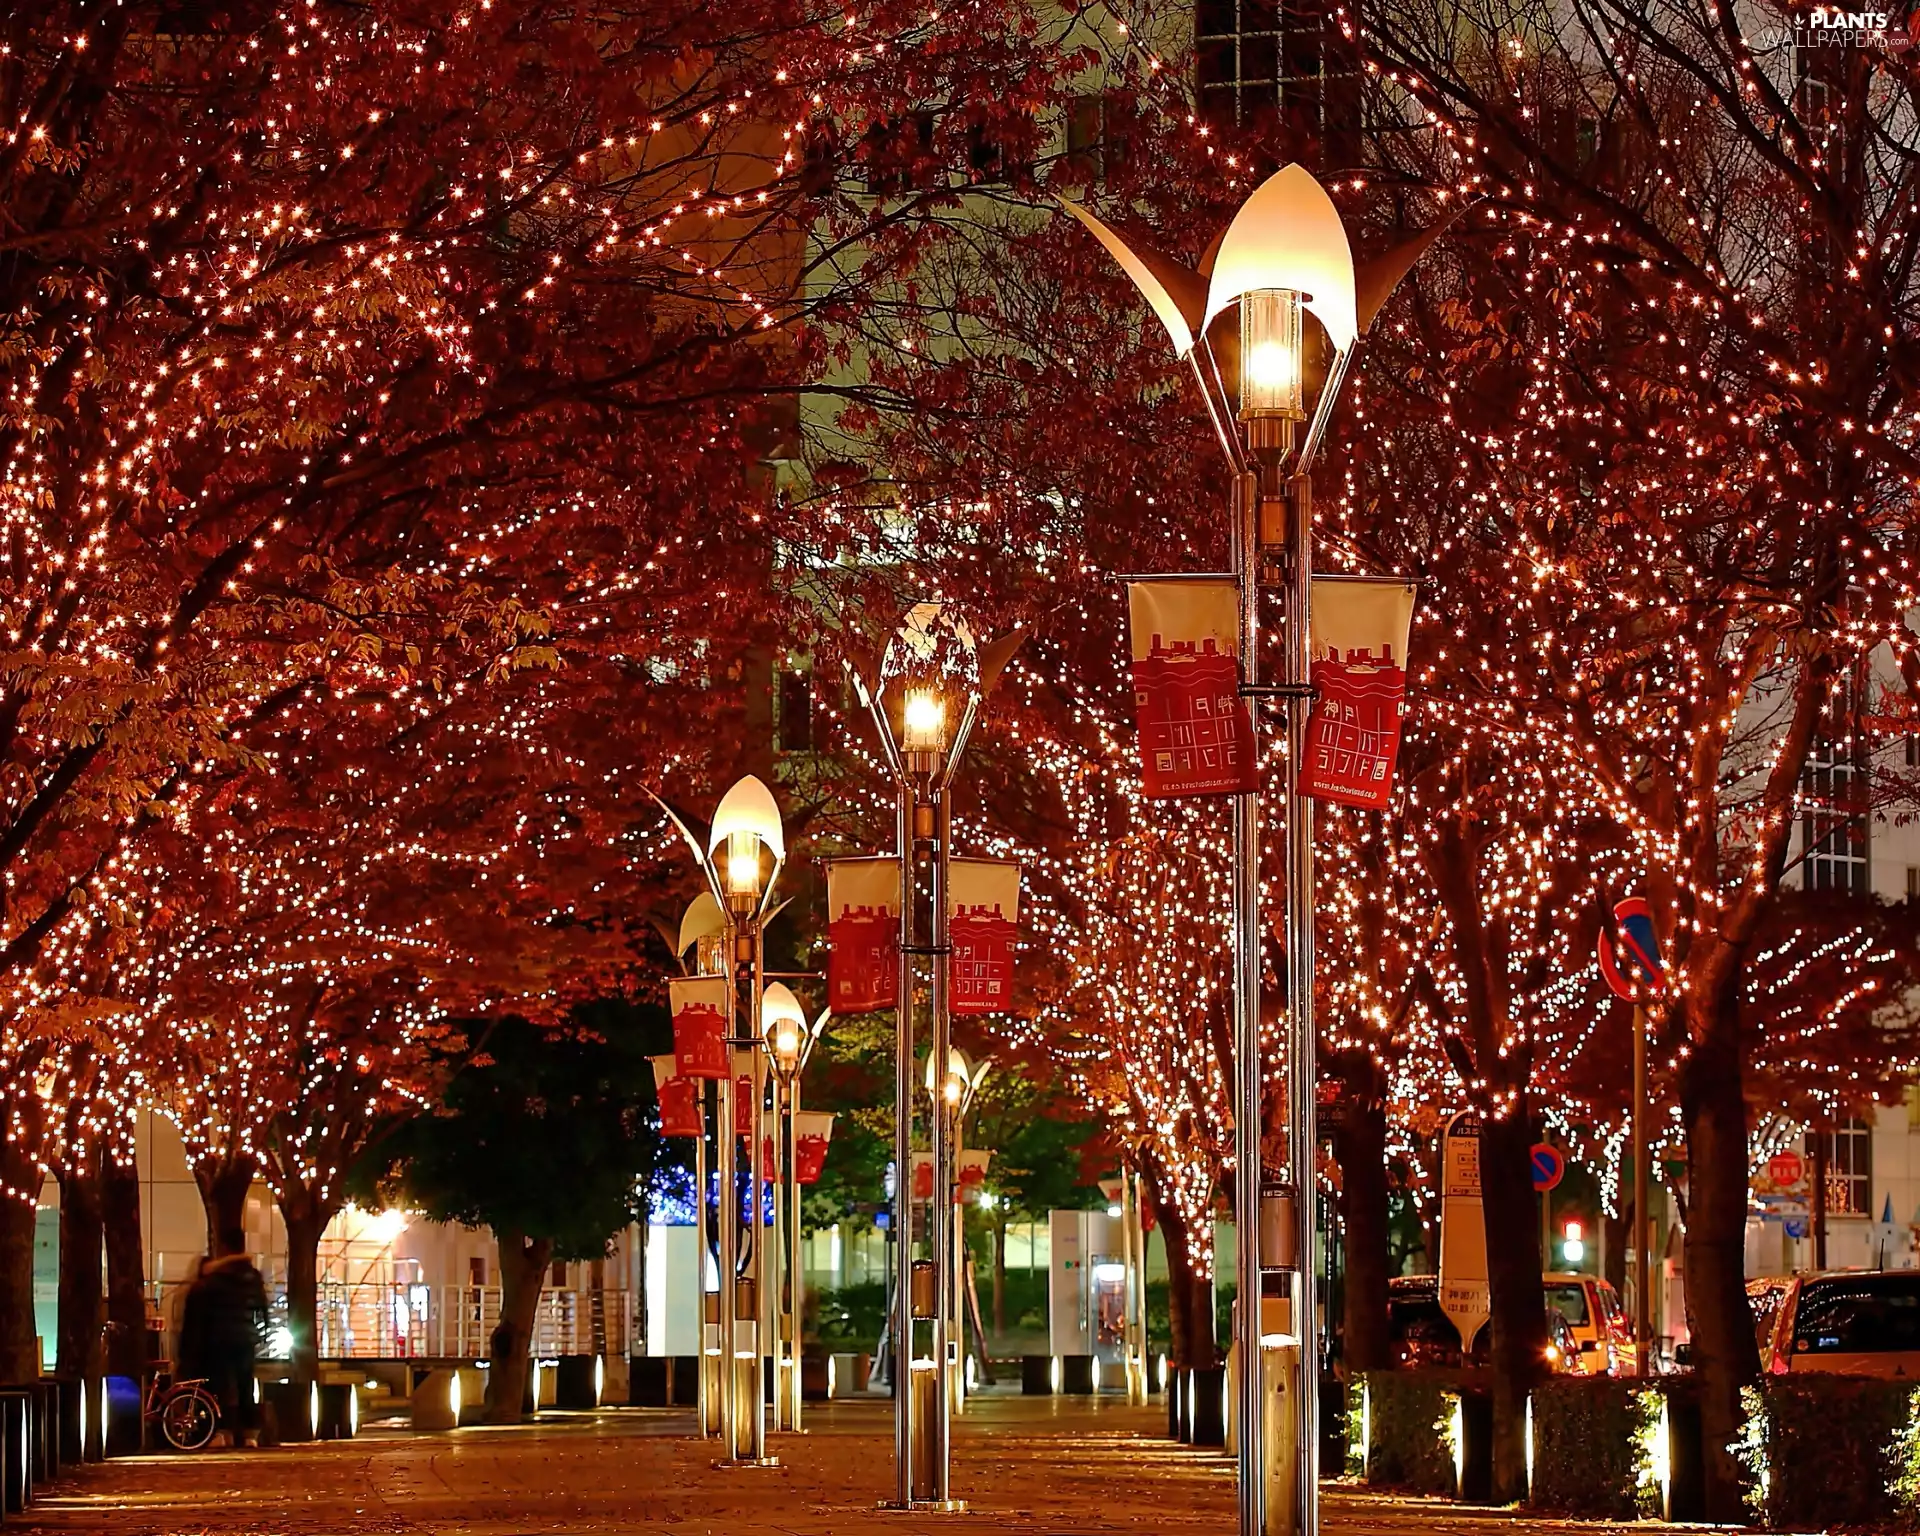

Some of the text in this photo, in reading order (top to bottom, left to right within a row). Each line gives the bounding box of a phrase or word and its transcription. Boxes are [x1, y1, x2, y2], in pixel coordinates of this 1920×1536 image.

[1323, 698, 1355, 722] 神戸
[1321, 723, 1390, 753] ハーバー
[1318, 749, 1371, 777] ランド
